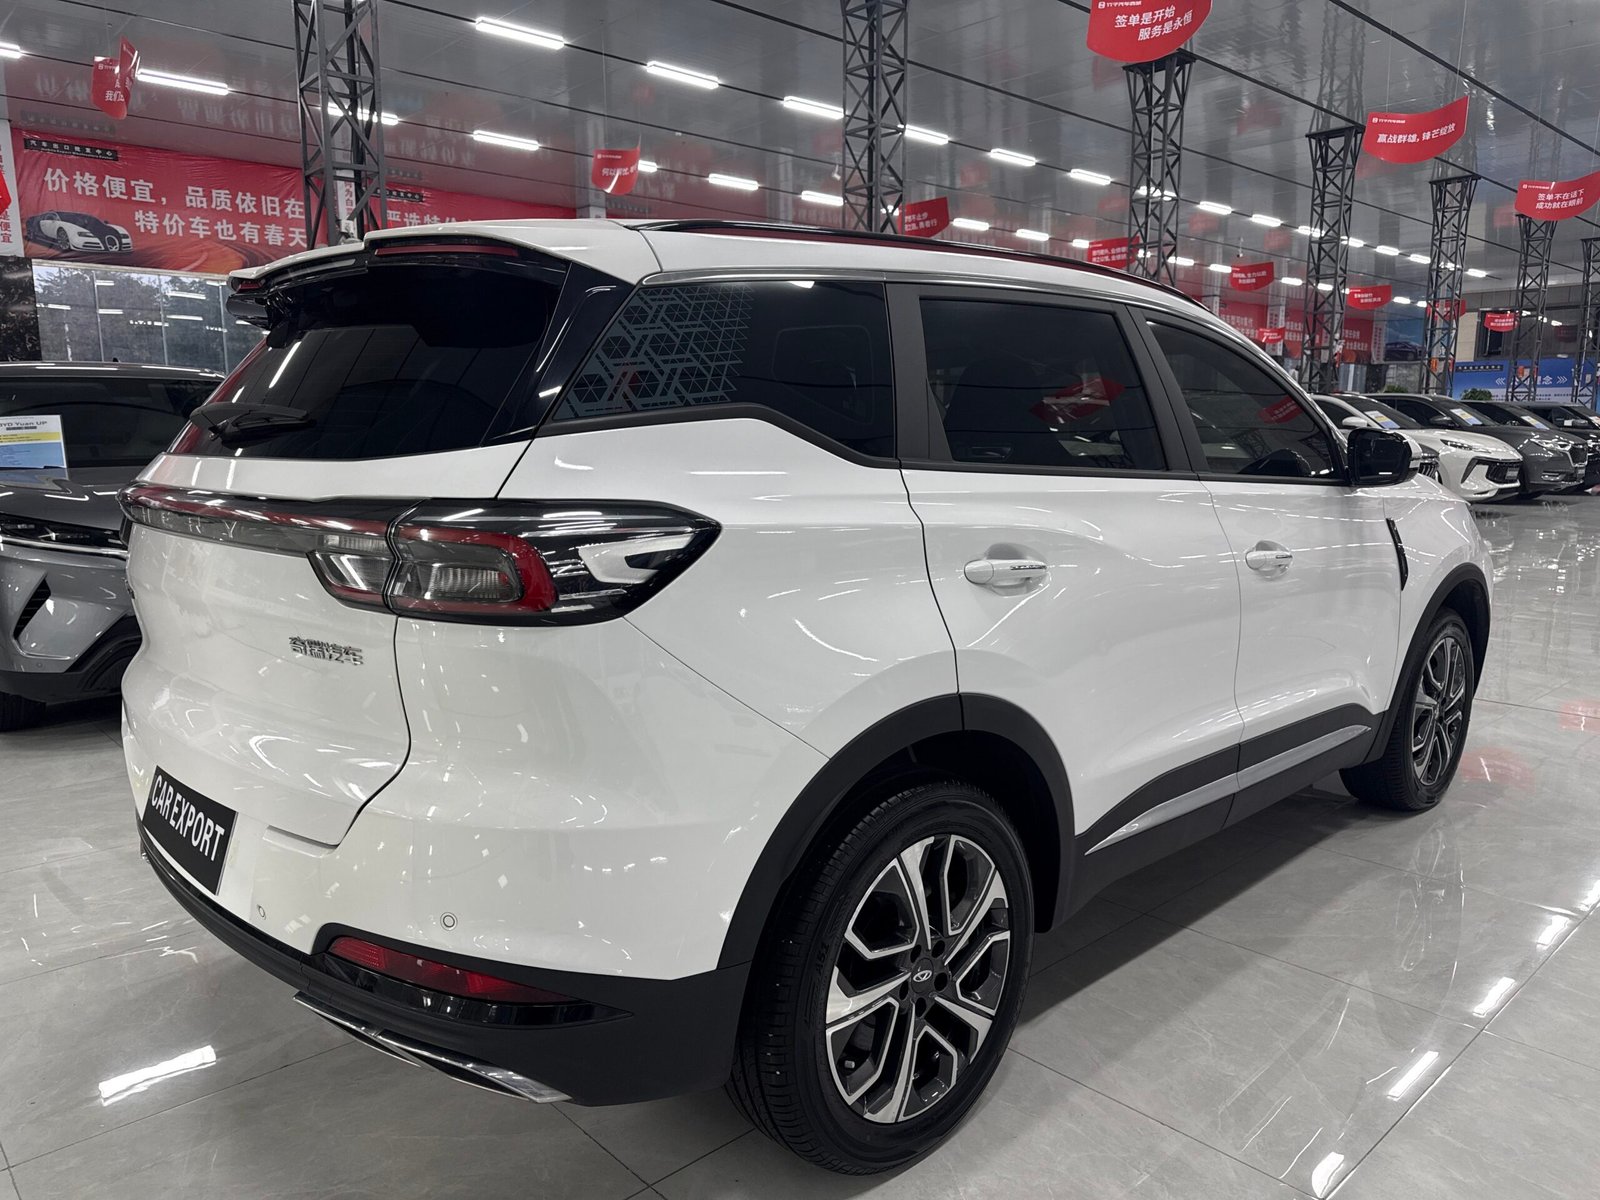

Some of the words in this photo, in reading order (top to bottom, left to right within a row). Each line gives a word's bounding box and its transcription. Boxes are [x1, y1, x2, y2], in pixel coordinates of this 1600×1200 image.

[1114, 5, 1176, 28] 签单是开始
[1138, 10, 1193, 41] 服务是永恒
[1537, 188, 1585, 201] 签单不在话下
[134, 209, 308, 248] 特价车也有春天
[151, 774, 174, 820] CAR
[169, 792, 225, 861] EXPORT
